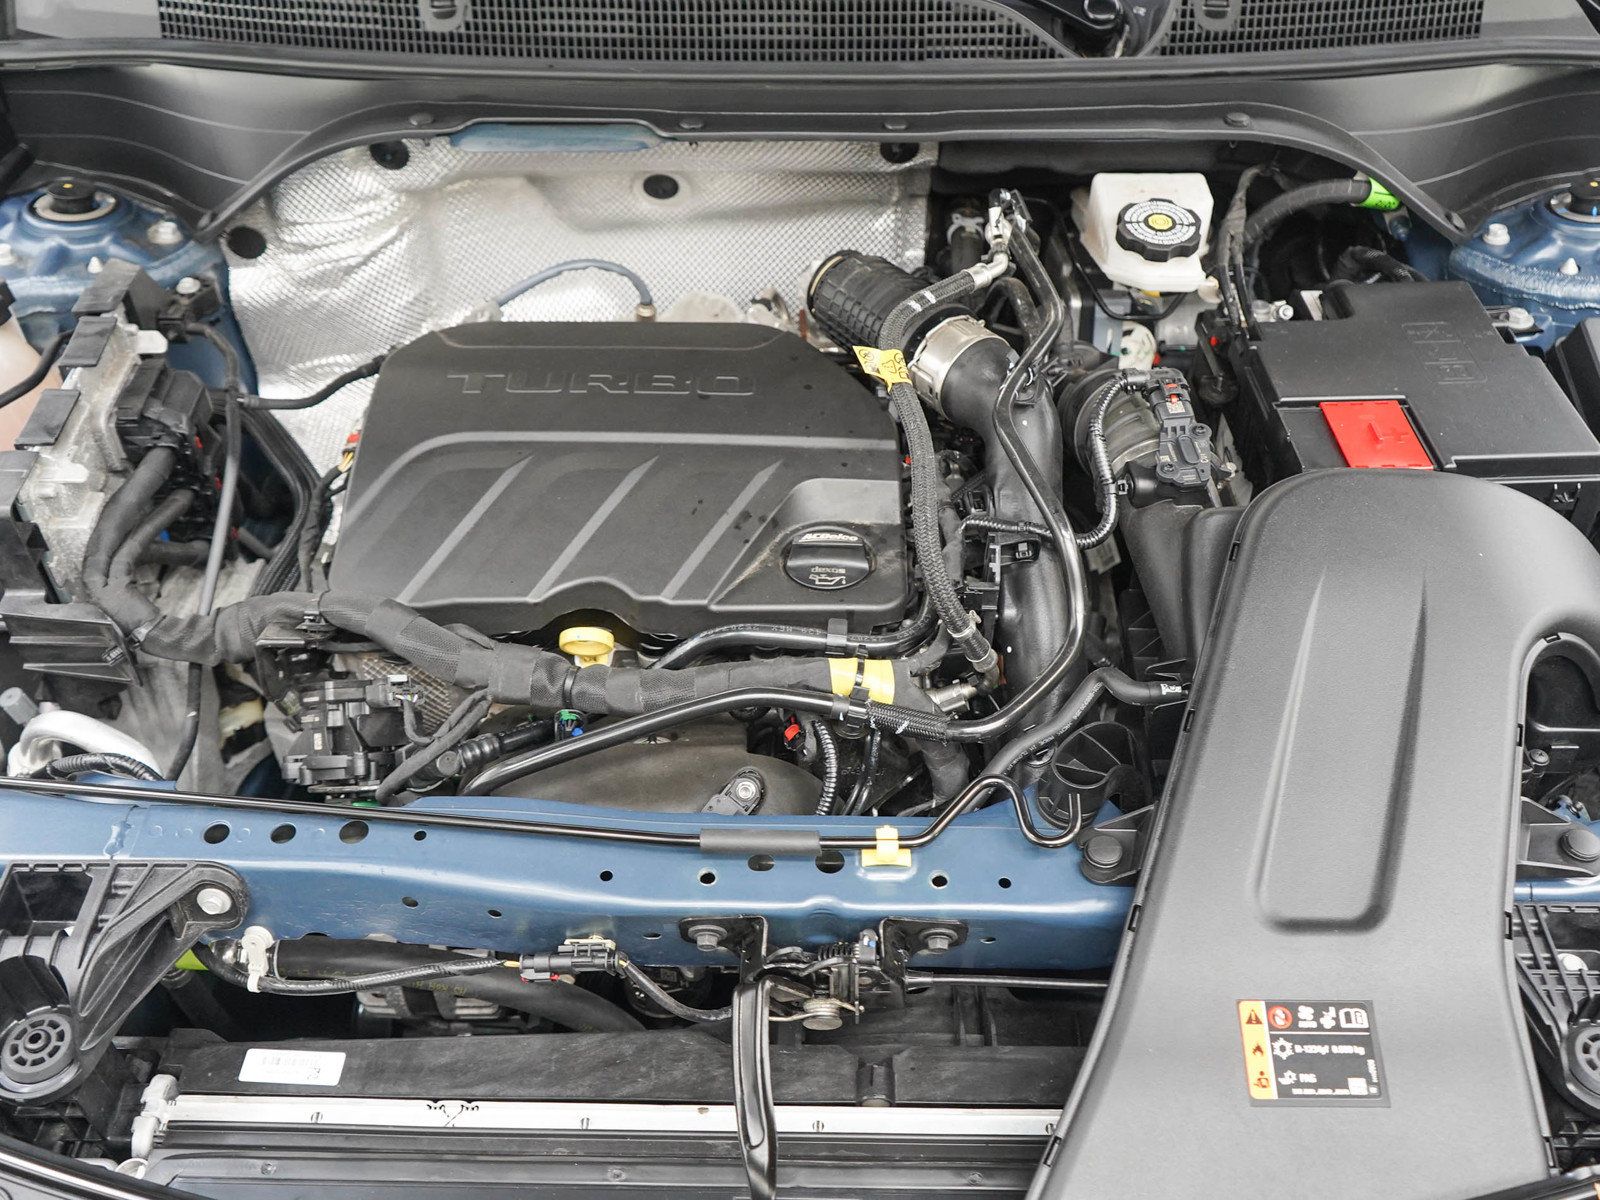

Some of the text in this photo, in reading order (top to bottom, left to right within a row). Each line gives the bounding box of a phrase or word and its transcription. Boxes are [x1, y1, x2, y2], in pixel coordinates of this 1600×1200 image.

[447, 373, 754, 396] TURBO
[799, 533, 859, 542] ACDelco
[811, 566, 846, 574] dexos
